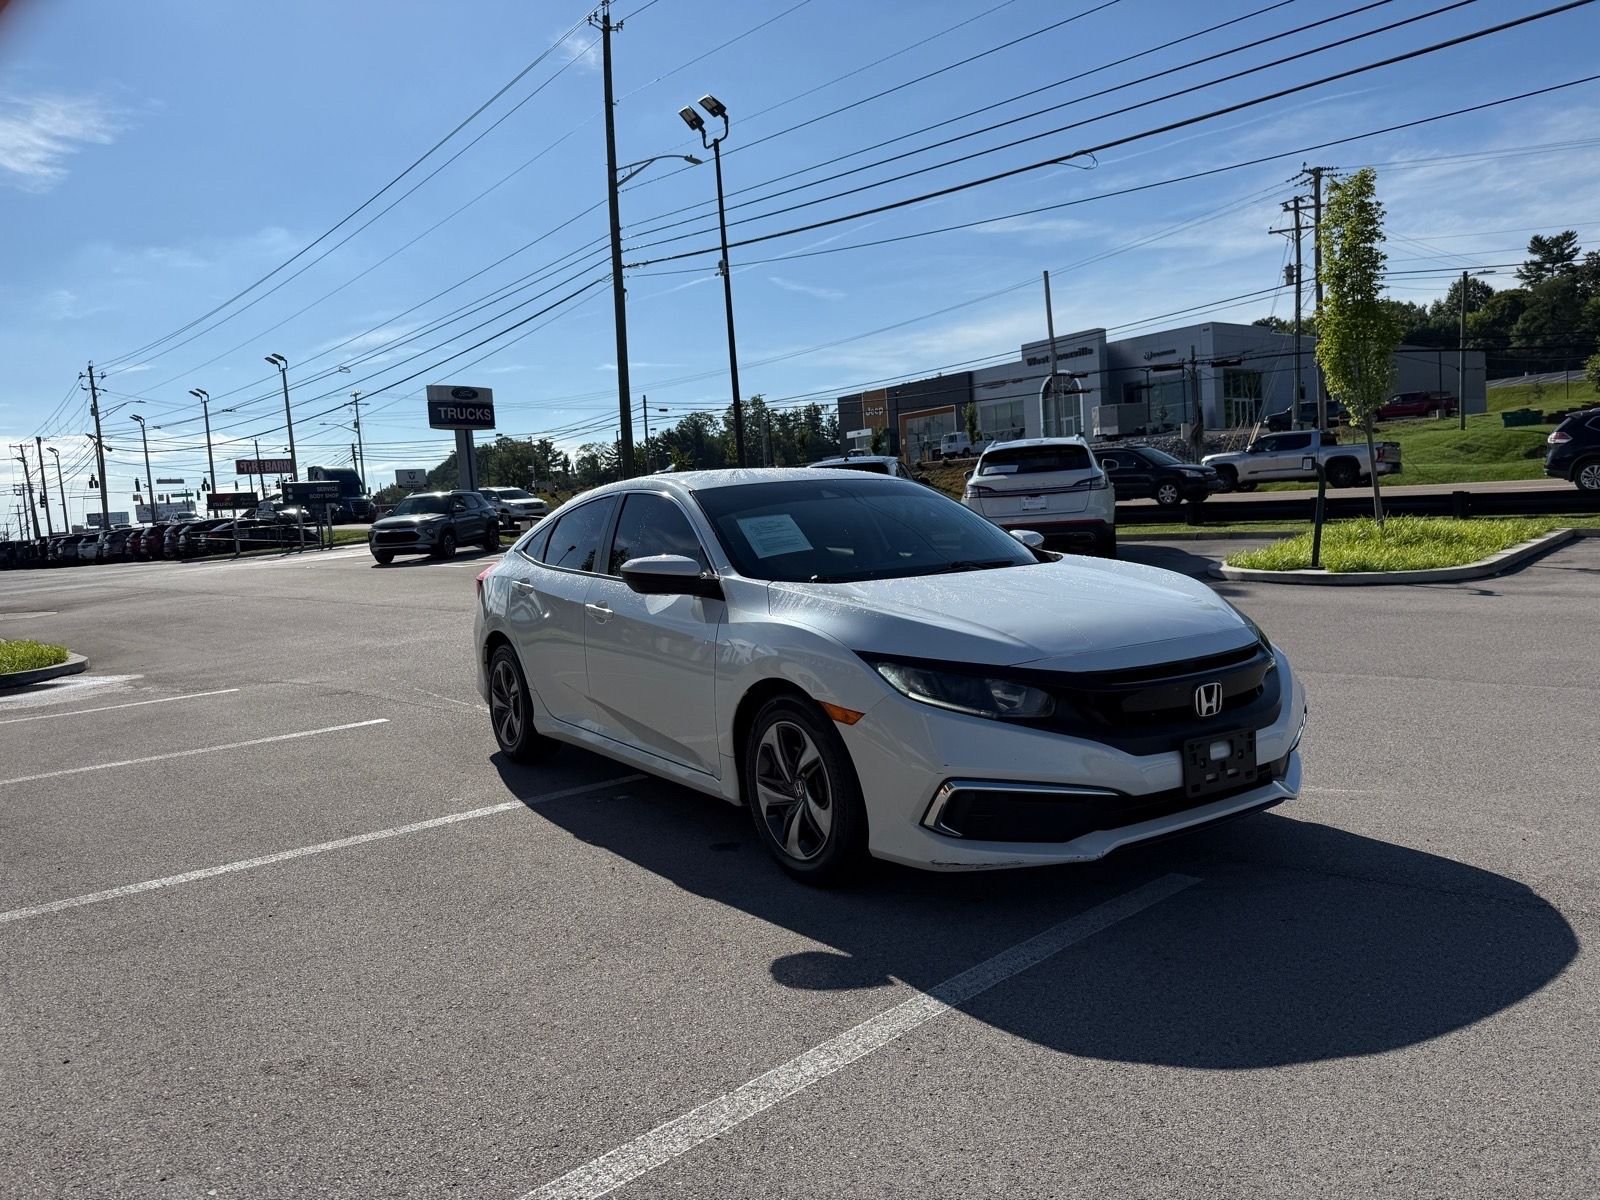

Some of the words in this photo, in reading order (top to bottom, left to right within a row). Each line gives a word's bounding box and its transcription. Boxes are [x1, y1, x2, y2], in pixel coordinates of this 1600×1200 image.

[1052, 346, 1093, 361] noxville
[437, 407, 492, 420] TRUCKS
[865, 406, 884, 416] Jeep
[264, 460, 291, 472] BARN
